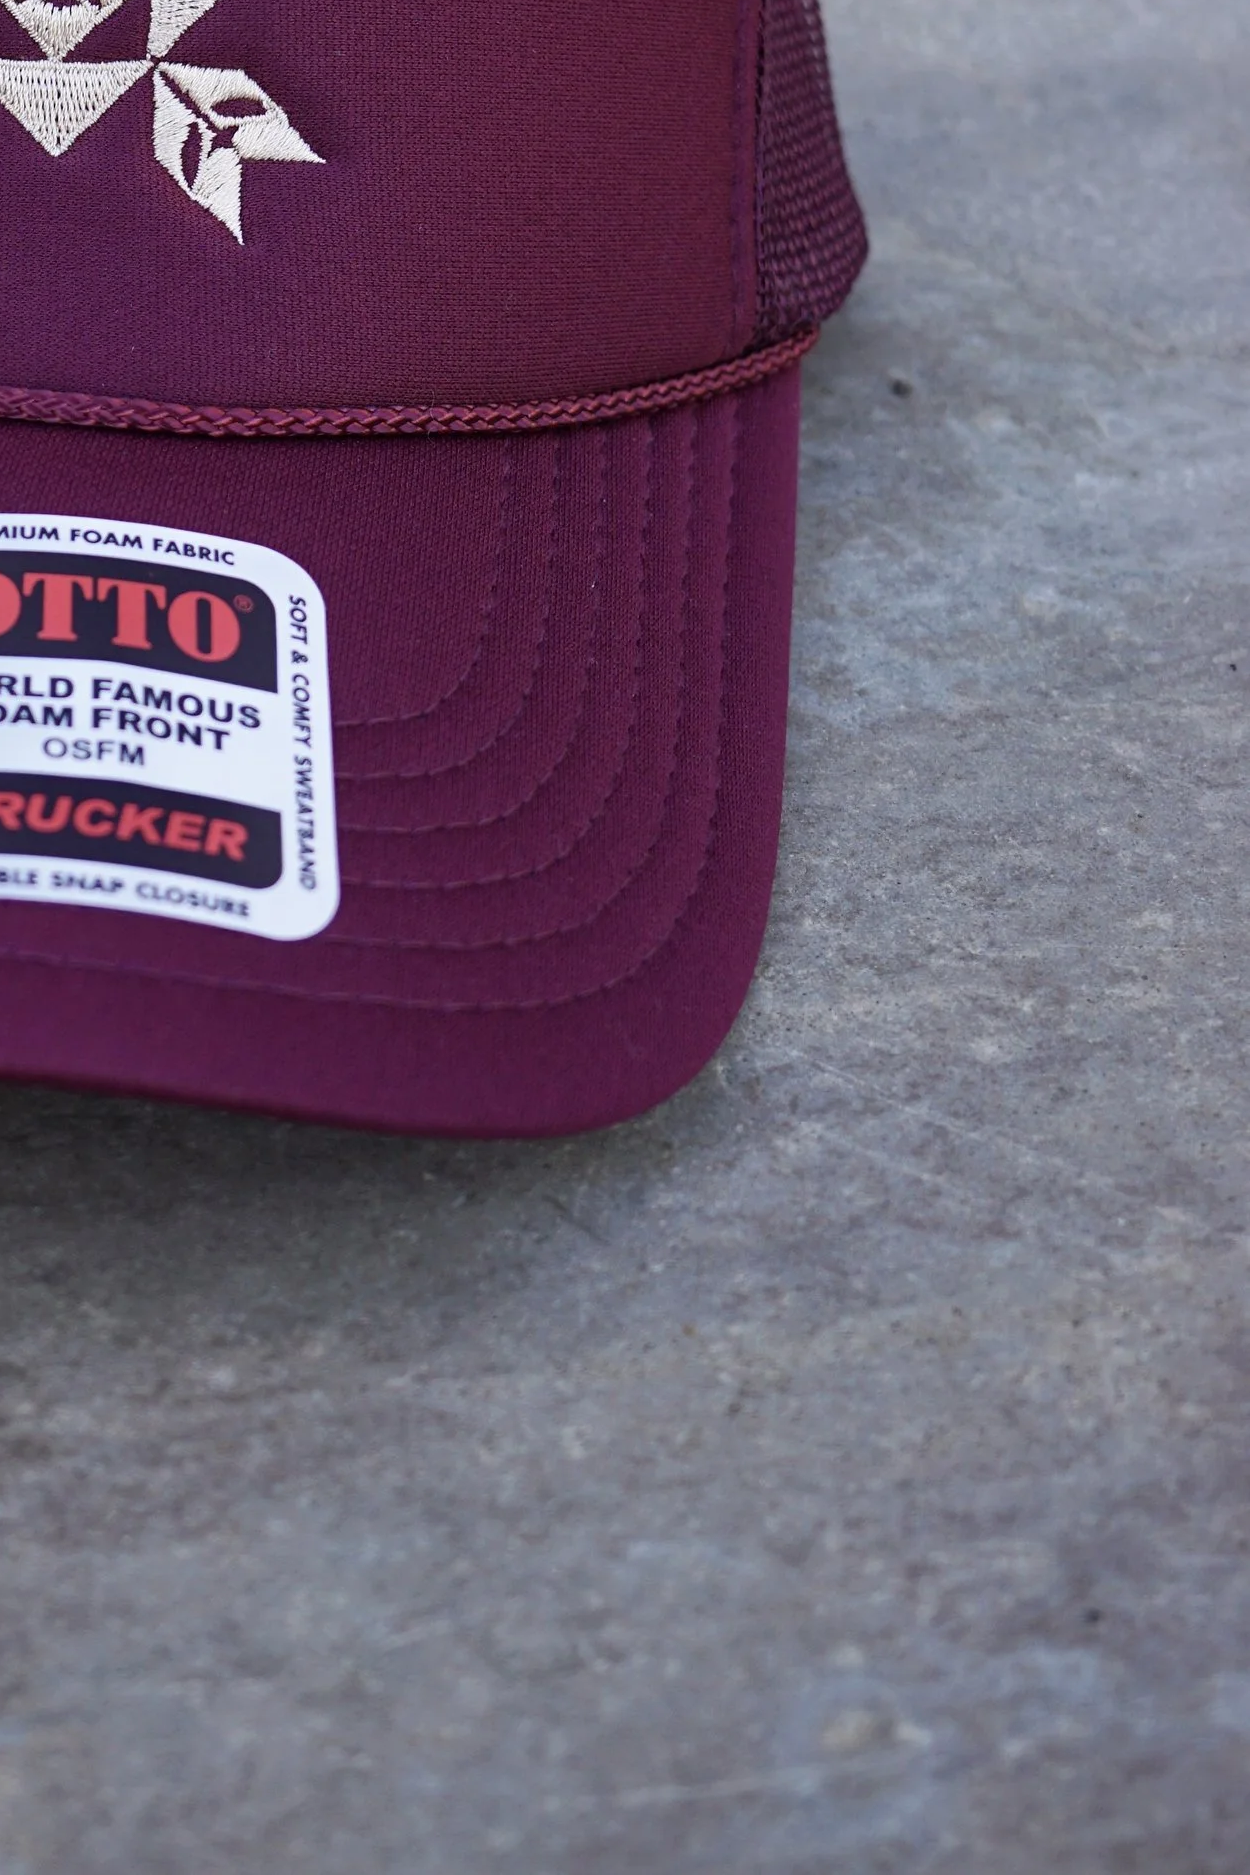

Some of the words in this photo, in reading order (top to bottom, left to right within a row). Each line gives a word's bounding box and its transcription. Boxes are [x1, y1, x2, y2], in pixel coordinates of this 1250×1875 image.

[70, 528, 143, 550] FOAM
[152, 536, 236, 566] FABRIC
[288, 595, 308, 645] SOFT
[291, 651, 309, 665] &
[91, 676, 261, 728] FAMOUS
[291, 673, 314, 750] COMFY
[42, 738, 146, 766] OSFM
[91, 708, 230, 752] FRONT
[293, 755, 317, 890] SWEATBAND
[51, 872, 123, 895] SNAP
[135, 882, 250, 918] CLOSURE
